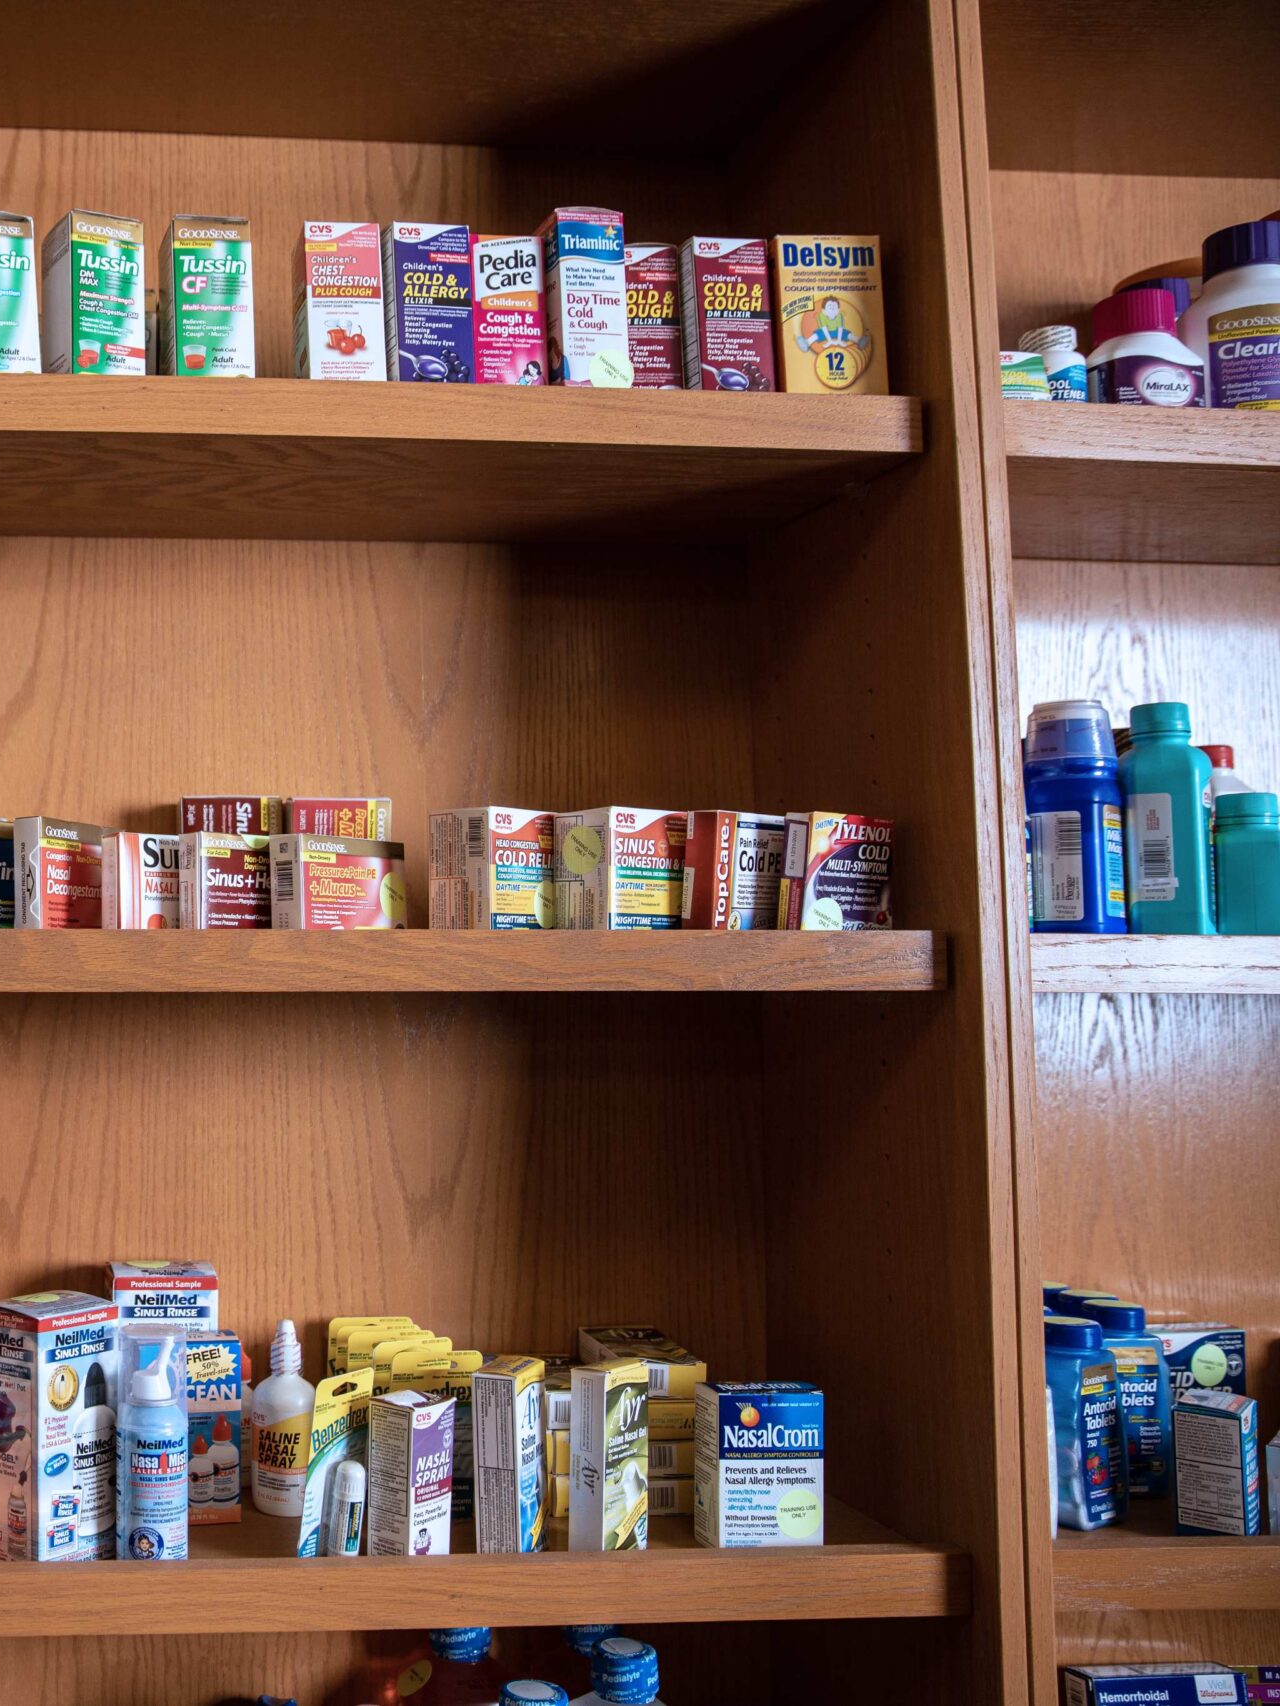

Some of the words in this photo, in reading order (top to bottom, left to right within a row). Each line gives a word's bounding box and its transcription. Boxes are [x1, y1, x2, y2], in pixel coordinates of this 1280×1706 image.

[310, 225, 332, 234] CVS
[561, 234, 620, 251] Triaminic
[698, 242, 720, 251] CVS
[479, 250, 536, 274] Pedia
[783, 243, 875, 268] Delsym
[78, 250, 138, 275] Tussin
[179, 255, 246, 274] Tussin
[403, 262, 443, 271] Children's
[312, 265, 344, 276] CHEST
[181, 275, 208, 295] CF
[312, 275, 377, 287] CONGESTION
[404, 272, 443, 285] COLD
[485, 270, 532, 291] Care
[315, 287, 338, 296] PLUS
[340, 288, 372, 296] COUGH
[403, 284, 468, 299] ALLERGY
[704, 283, 749, 298] COLD
[405, 296, 433, 305] ELIXIR
[488, 298, 532, 307] Children's
[567, 293, 590, 308] Day
[591, 293, 620, 305] Time
[704, 296, 762, 311] COUGH
[486, 312, 521, 324] Cough
[568, 306, 593, 319] Cold
[706, 310, 721, 318] DM
[723, 310, 751, 318] ELIXIR
[479, 324, 540, 337] Congestion
[578, 319, 607, 330] Cough
[825, 352, 844, 370] 12
[1146, 381, 1190, 393] MiraLAX
[495, 813, 512, 825] CVS
[616, 813, 635, 824] CVS
[616, 838, 655, 855] SINUS
[740, 838, 752, 848] Pain
[753, 839, 768, 849] Relief
[495, 851, 526, 865] COLD
[859, 844, 889, 861] COLD
[616, 856, 672, 869] CONGESTION
[739, 851, 765, 872] Cold
[496, 883, 520, 891] DAYTIME
[616, 882, 644, 890] DAYTIME
[616, 916, 652, 925] NIGHTTIME
[130, 1280, 172, 1288] Professional
[173, 1280, 201, 1289] Sample
[134, 1294, 197, 1306] NeilMed
[134, 1307, 165, 1317] SINUS
[167, 1308, 198, 1317] RINSE
[52, 1316, 86, 1327] Professional
[88, 1312, 108, 1322] Sample
[55, 1328, 105, 1346] NeilMed
[195, 1367, 230, 1379] Travel-size
[1084, 1396, 1116, 1416] Antacid
[416, 1412, 432, 1423] CVS
[1085, 1414, 1116, 1431] Tablets
[312, 1406, 369, 1453] Benzedrex
[724, 1423, 818, 1448] NasalCrom
[258, 1429, 301, 1444] SALINE
[608, 1434, 624, 1447] Saline
[639, 1426, 647, 1439] Gel
[137, 1439, 183, 1449] NeilMed
[258, 1442, 296, 1457] NASAL
[1087, 1439, 1097, 1448] 750
[258, 1455, 296, 1469] SPRAY
[417, 1451, 450, 1470] NASAL
[415, 1464, 449, 1487] SPRAY
[725, 1466, 758, 1475] Prevents
[776, 1466, 806, 1474] Relieves
[725, 1477, 746, 1485] Nasal
[748, 1477, 774, 1485] Allergy
[440, 1630, 476, 1644] Pedialyte
[602, 1670, 640, 1684] Pedialyte
[1099, 1690, 1169, 1703] Hemorrhoidal
